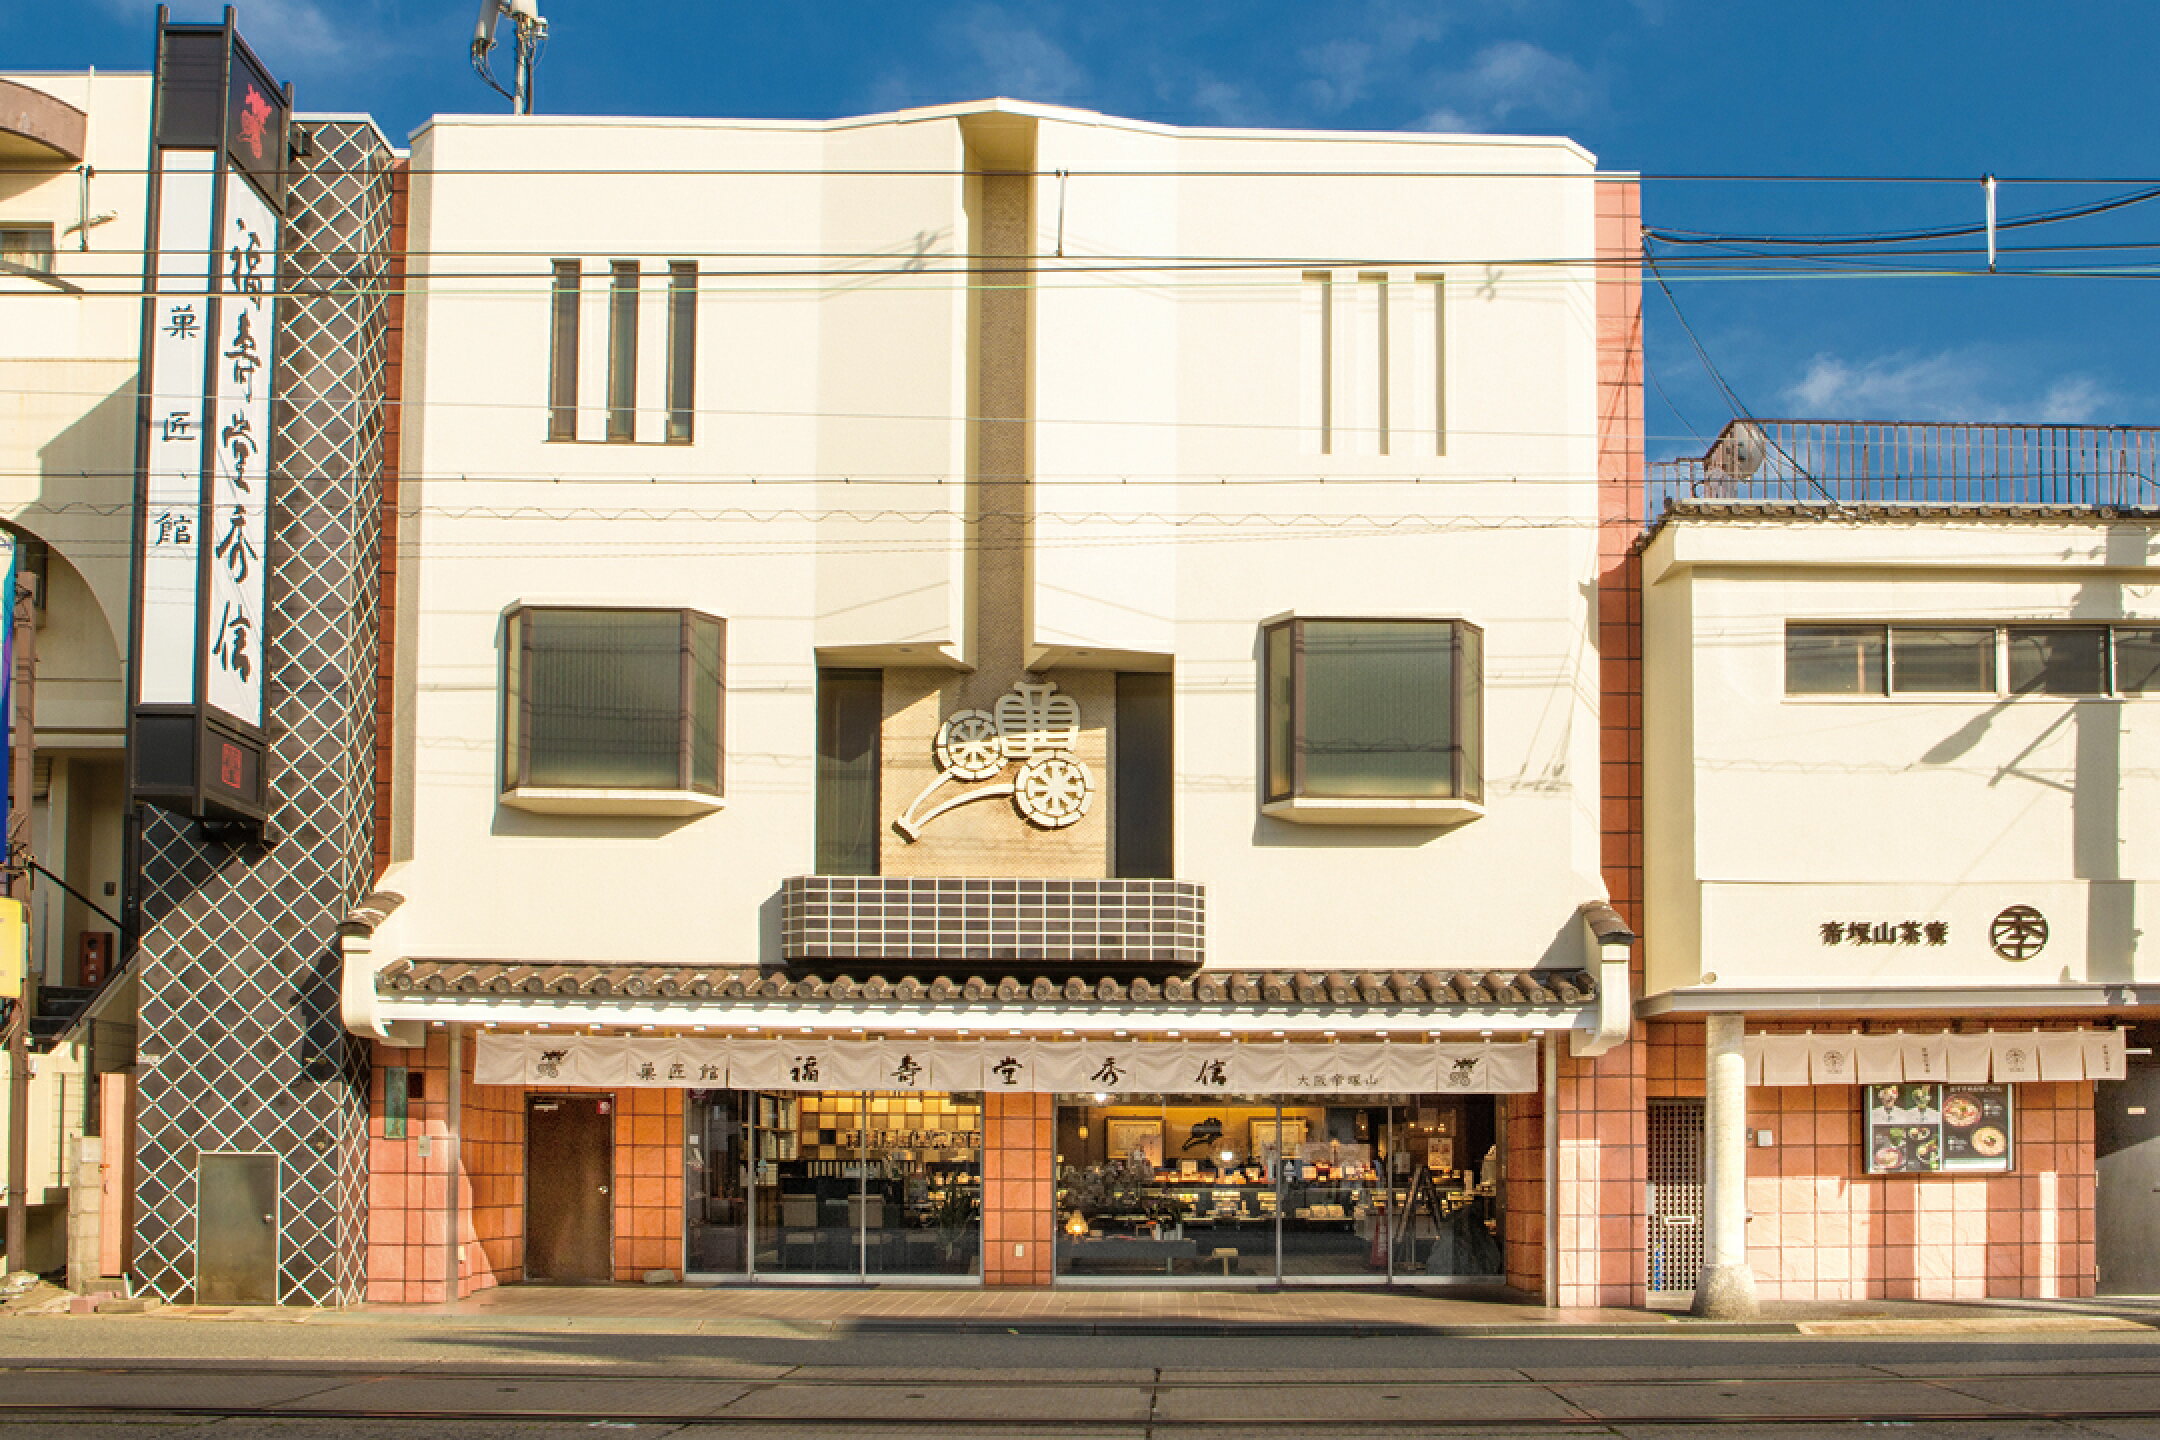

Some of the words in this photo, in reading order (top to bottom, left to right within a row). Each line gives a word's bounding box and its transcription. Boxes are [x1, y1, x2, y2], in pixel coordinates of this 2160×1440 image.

[154, 304, 200, 545] 菓匠館
[790, 1054, 1227, 1086] 福寿堂秀信
